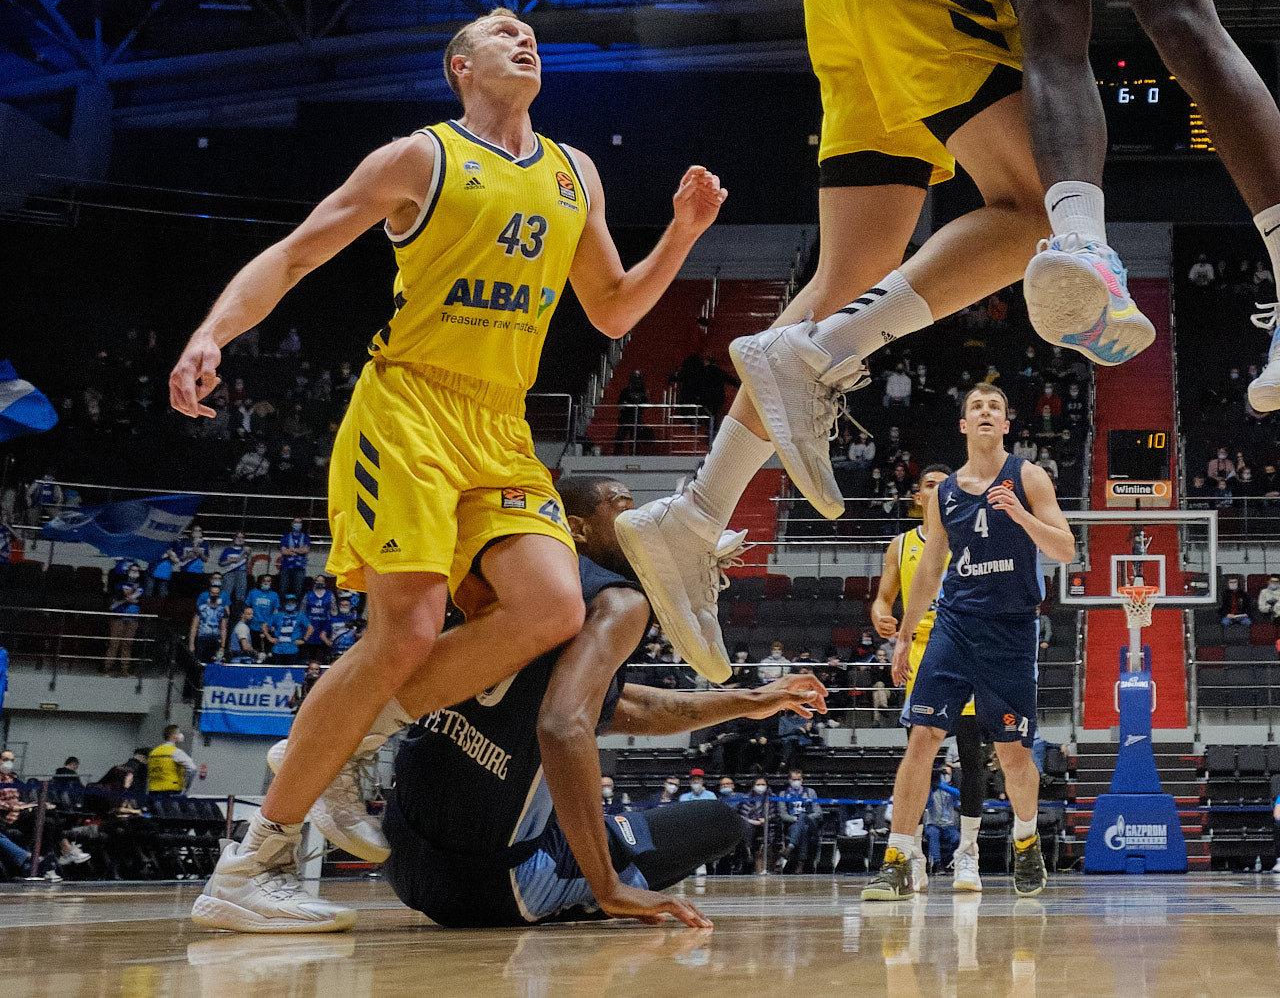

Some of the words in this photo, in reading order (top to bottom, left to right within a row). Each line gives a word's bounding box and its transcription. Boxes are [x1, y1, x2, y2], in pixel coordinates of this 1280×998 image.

[497, 212, 549, 261] 43
[443, 277, 530, 314] ALBA
[441, 312, 490, 329] Treasure
[493, 319, 511, 331] raw
[1147, 432, 1165, 449] 10
[1115, 485, 1151, 494] Winline
[974, 508, 988, 537] 4
[972, 558, 1014, 576] GAZPROM
[211, 690, 270, 708] НАШЕ
[1018, 716, 1029, 737] 4
[424, 708, 512, 781] PETERSBURG
[1125, 824, 1167, 837] GAZPROM
